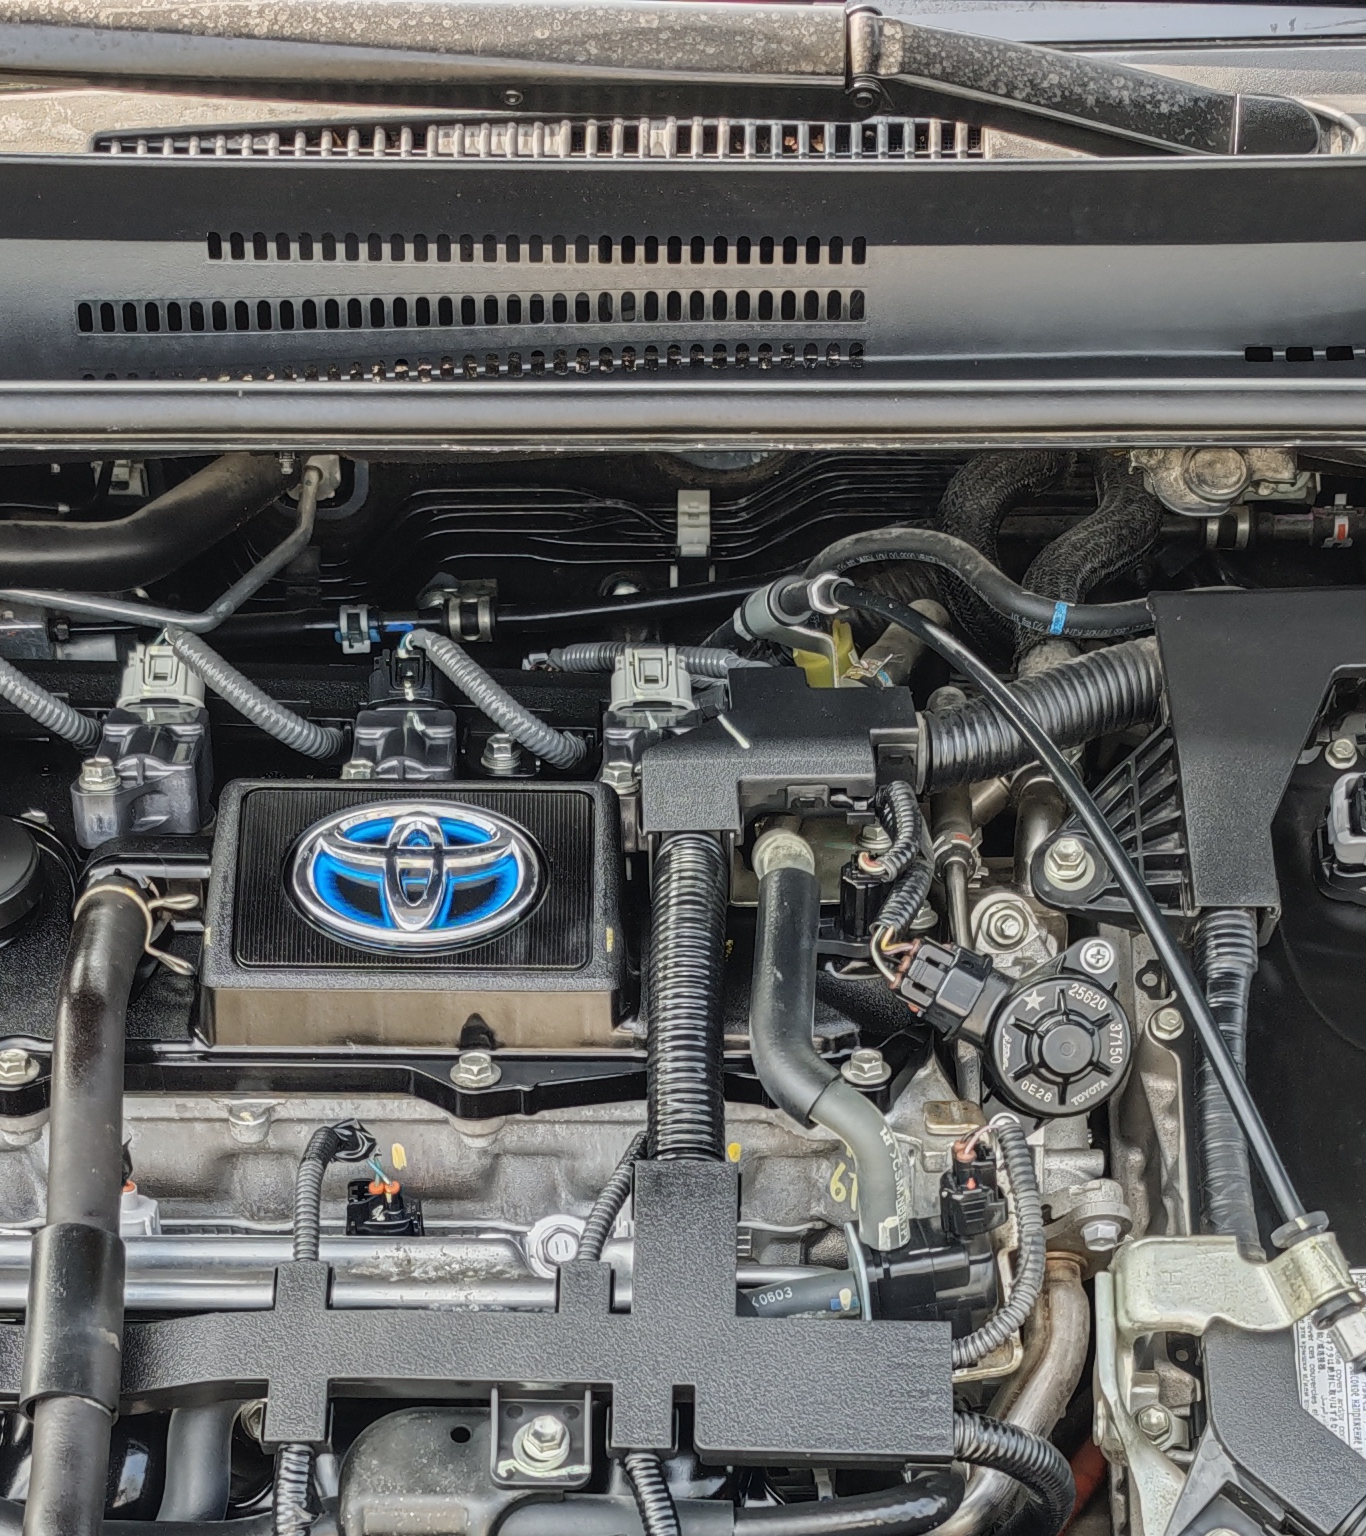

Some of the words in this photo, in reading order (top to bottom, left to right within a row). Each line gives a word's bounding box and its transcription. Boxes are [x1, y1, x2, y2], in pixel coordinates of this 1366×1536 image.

[1068, 983, 1107, 1011] 25620
[1109, 1023, 1123, 1064] 37150
[1020, 1080, 1053, 1103] 0E26
[1070, 1079, 1109, 1107] TOYOTA
